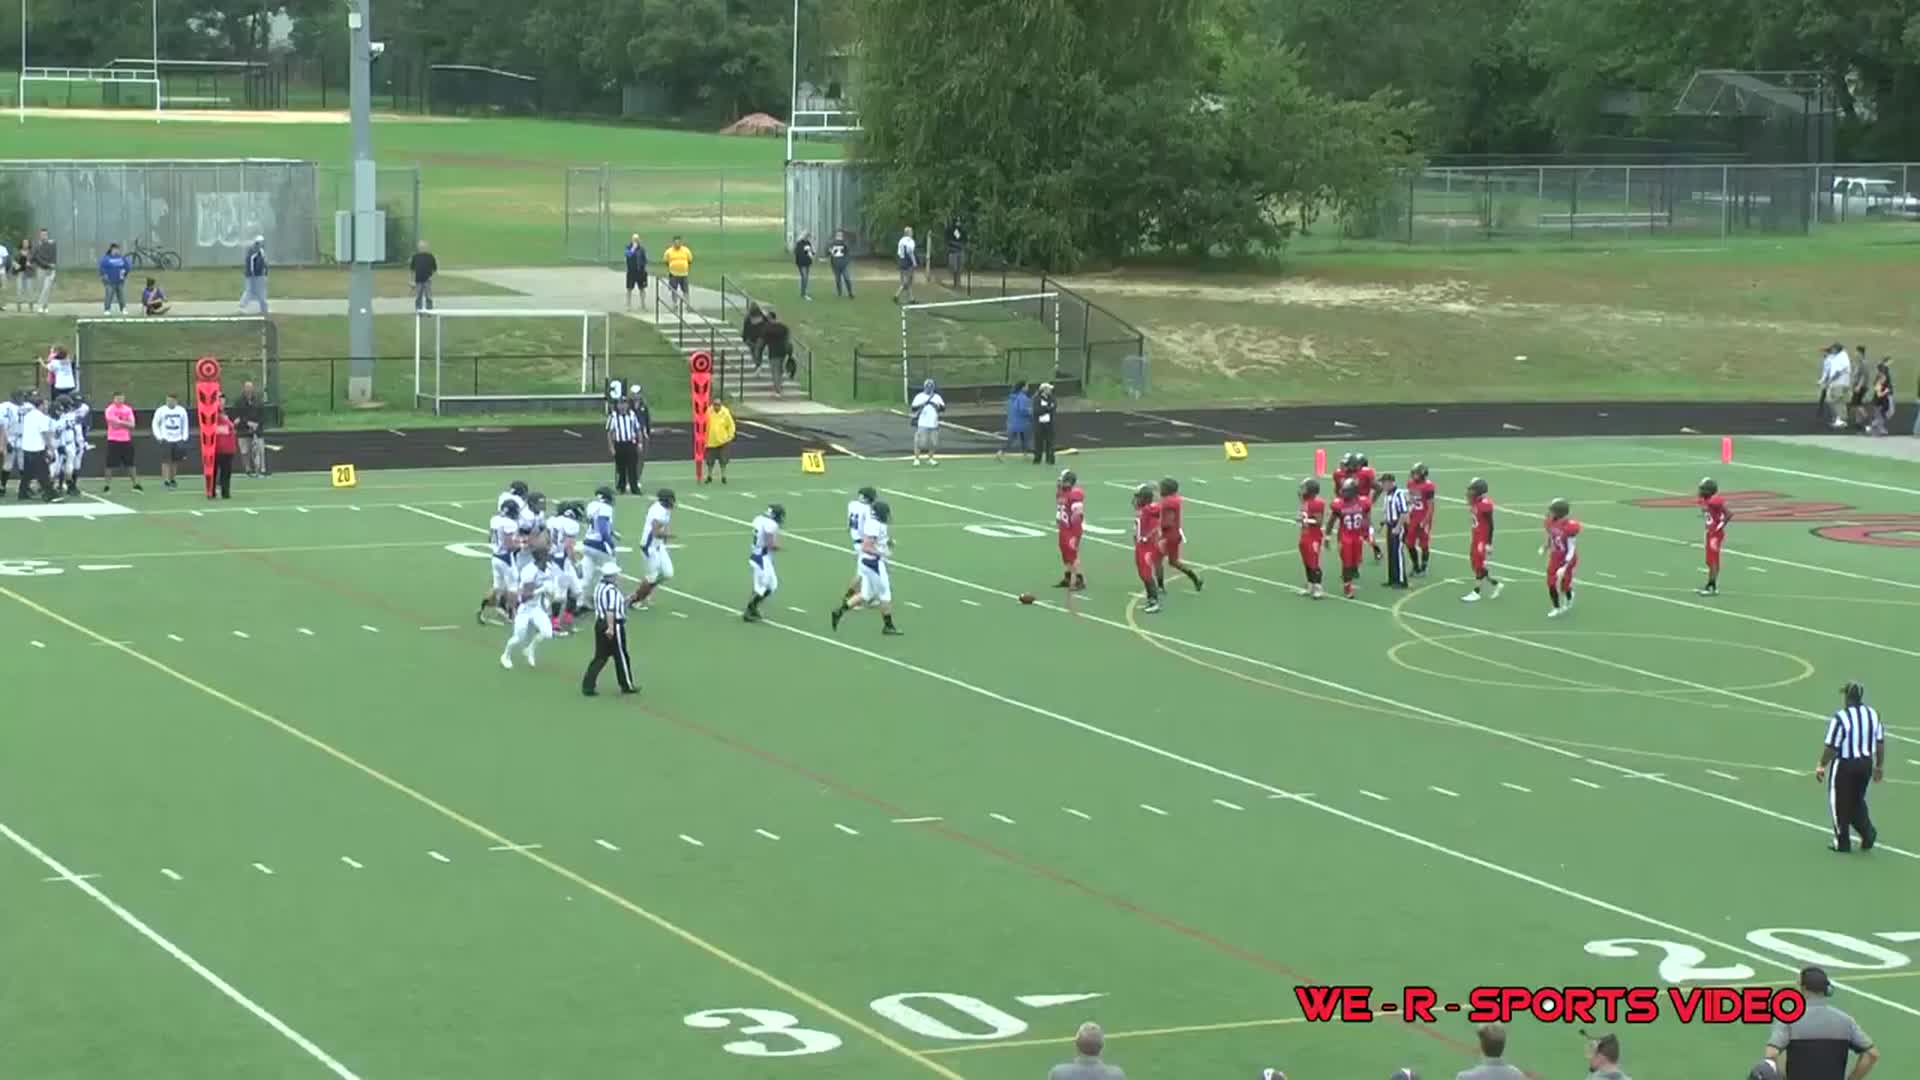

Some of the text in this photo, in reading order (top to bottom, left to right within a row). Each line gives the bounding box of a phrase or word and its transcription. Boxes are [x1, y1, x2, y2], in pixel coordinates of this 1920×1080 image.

[610, 380, 622, 399] 3
[808, 454, 821, 469] 10
[336, 466, 351, 483] 20
[1584, 928, 1911, 982] 20
[683, 992, 1028, 1056] 30
